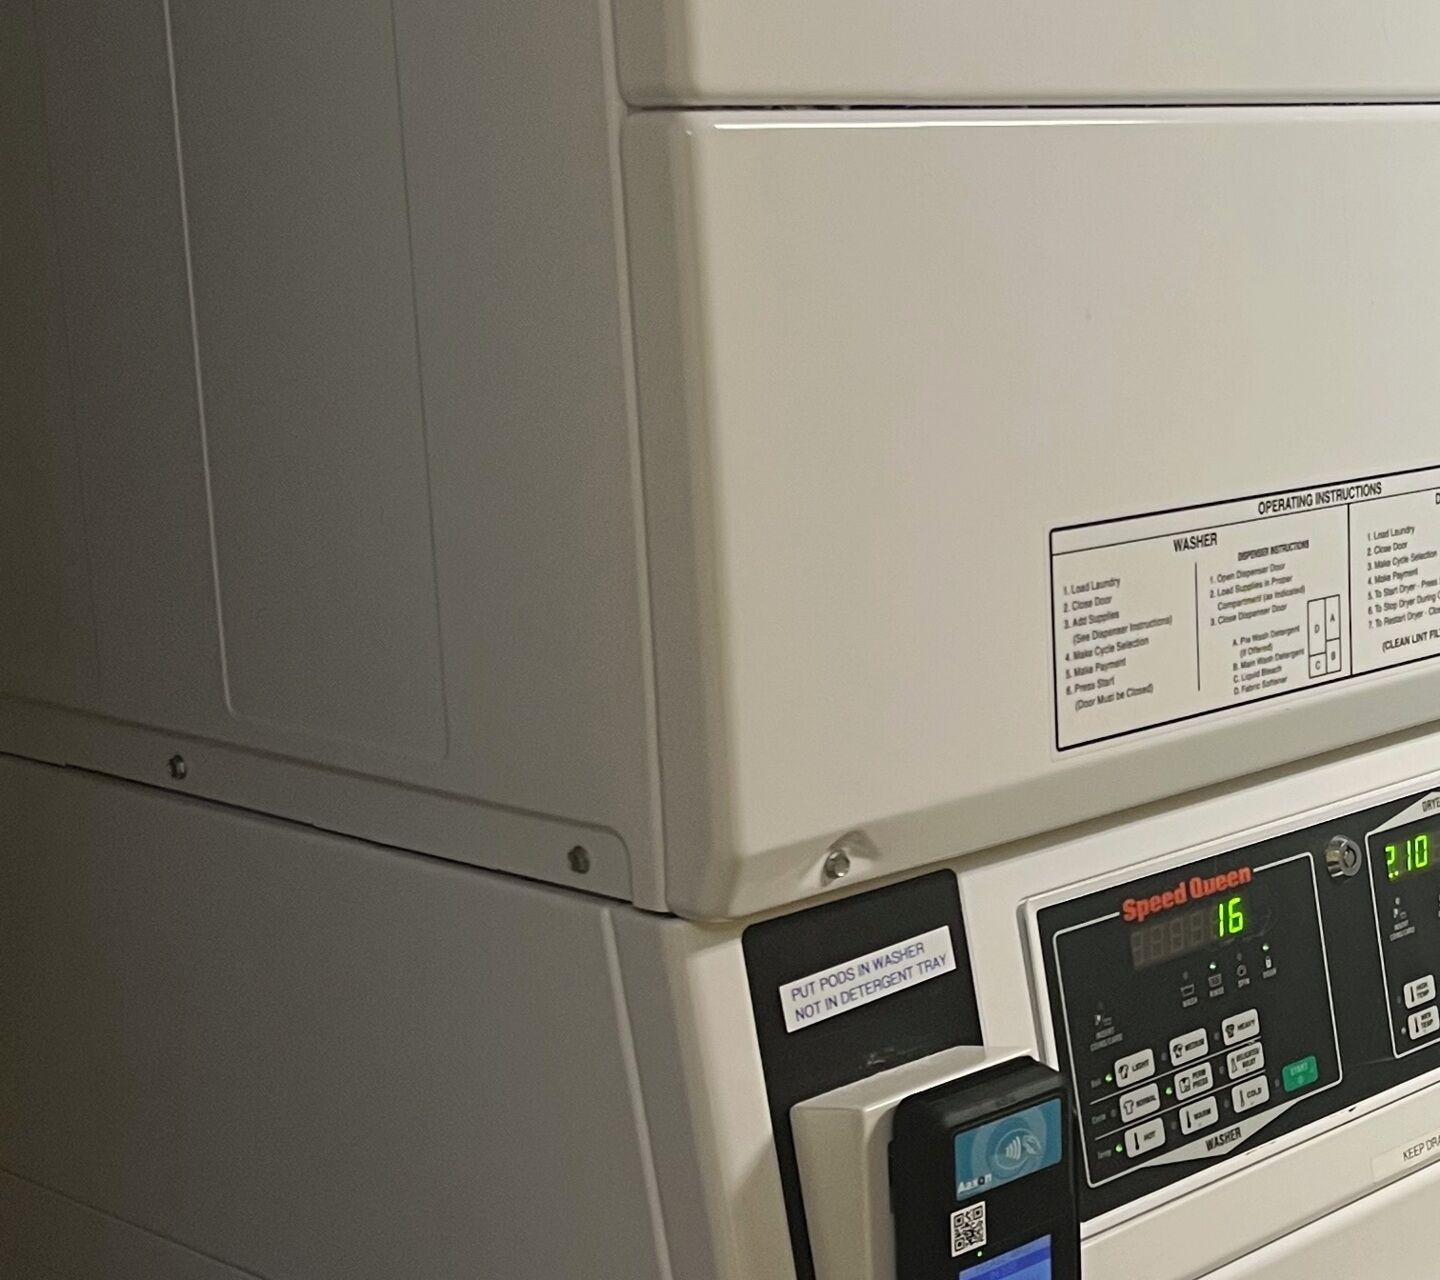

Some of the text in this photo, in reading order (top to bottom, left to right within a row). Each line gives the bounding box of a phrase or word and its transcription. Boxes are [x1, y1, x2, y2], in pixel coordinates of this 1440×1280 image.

[1258, 482, 1381, 514] OPERATING INSTRUCTIONS
[1173, 532, 1218, 552] WASHER
[1122, 866, 1252, 922] Speed Queen
[1217, 897, 1244, 937] 16
[791, 942, 925, 1002] PUT PODS IN WASHER
[795, 954, 946, 1022] NOT IN DETERGENT TRAY
[1205, 1127, 1242, 1151] WASHER
[1403, 1142, 1424, 1162] KEEP
[957, 1173, 992, 1192] Aaxon
